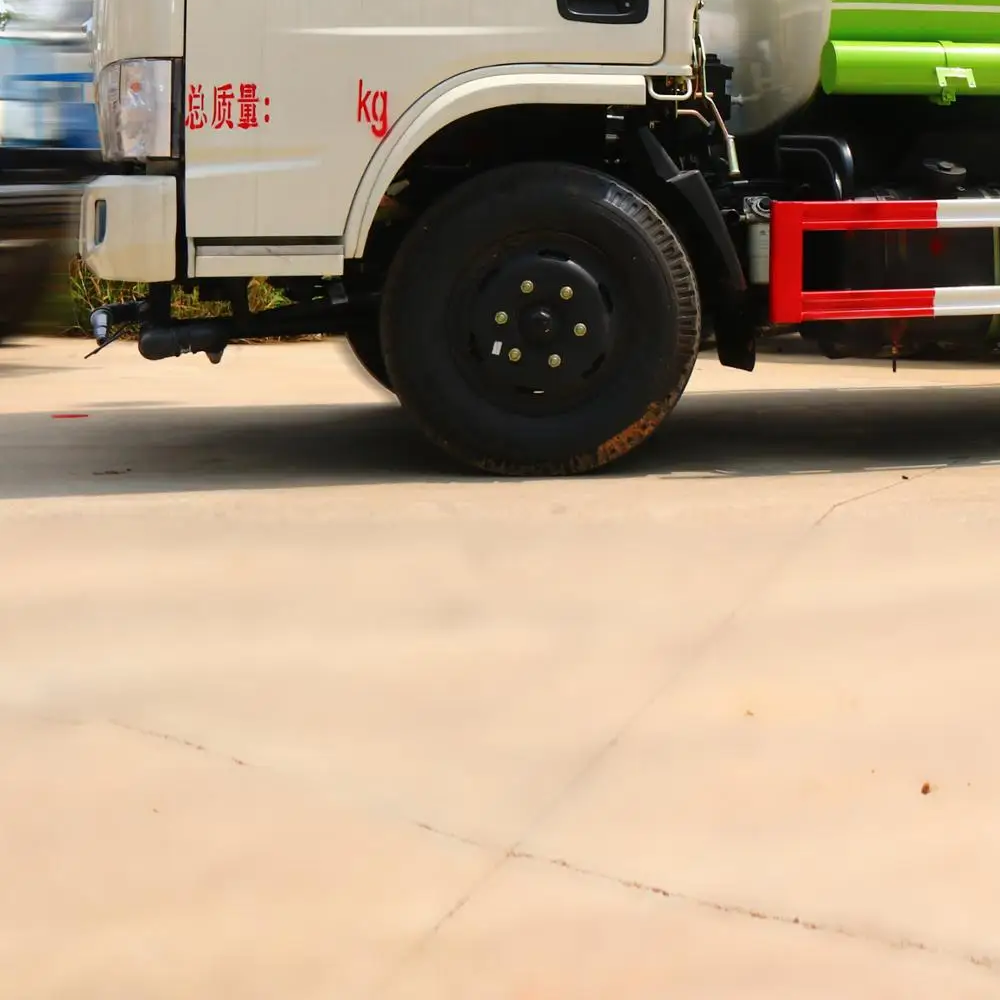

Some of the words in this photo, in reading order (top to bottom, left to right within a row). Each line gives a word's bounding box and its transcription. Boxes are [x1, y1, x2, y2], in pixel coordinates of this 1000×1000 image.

[184, 82, 271, 131] 总质量:
[357, 79, 389, 138] kg
